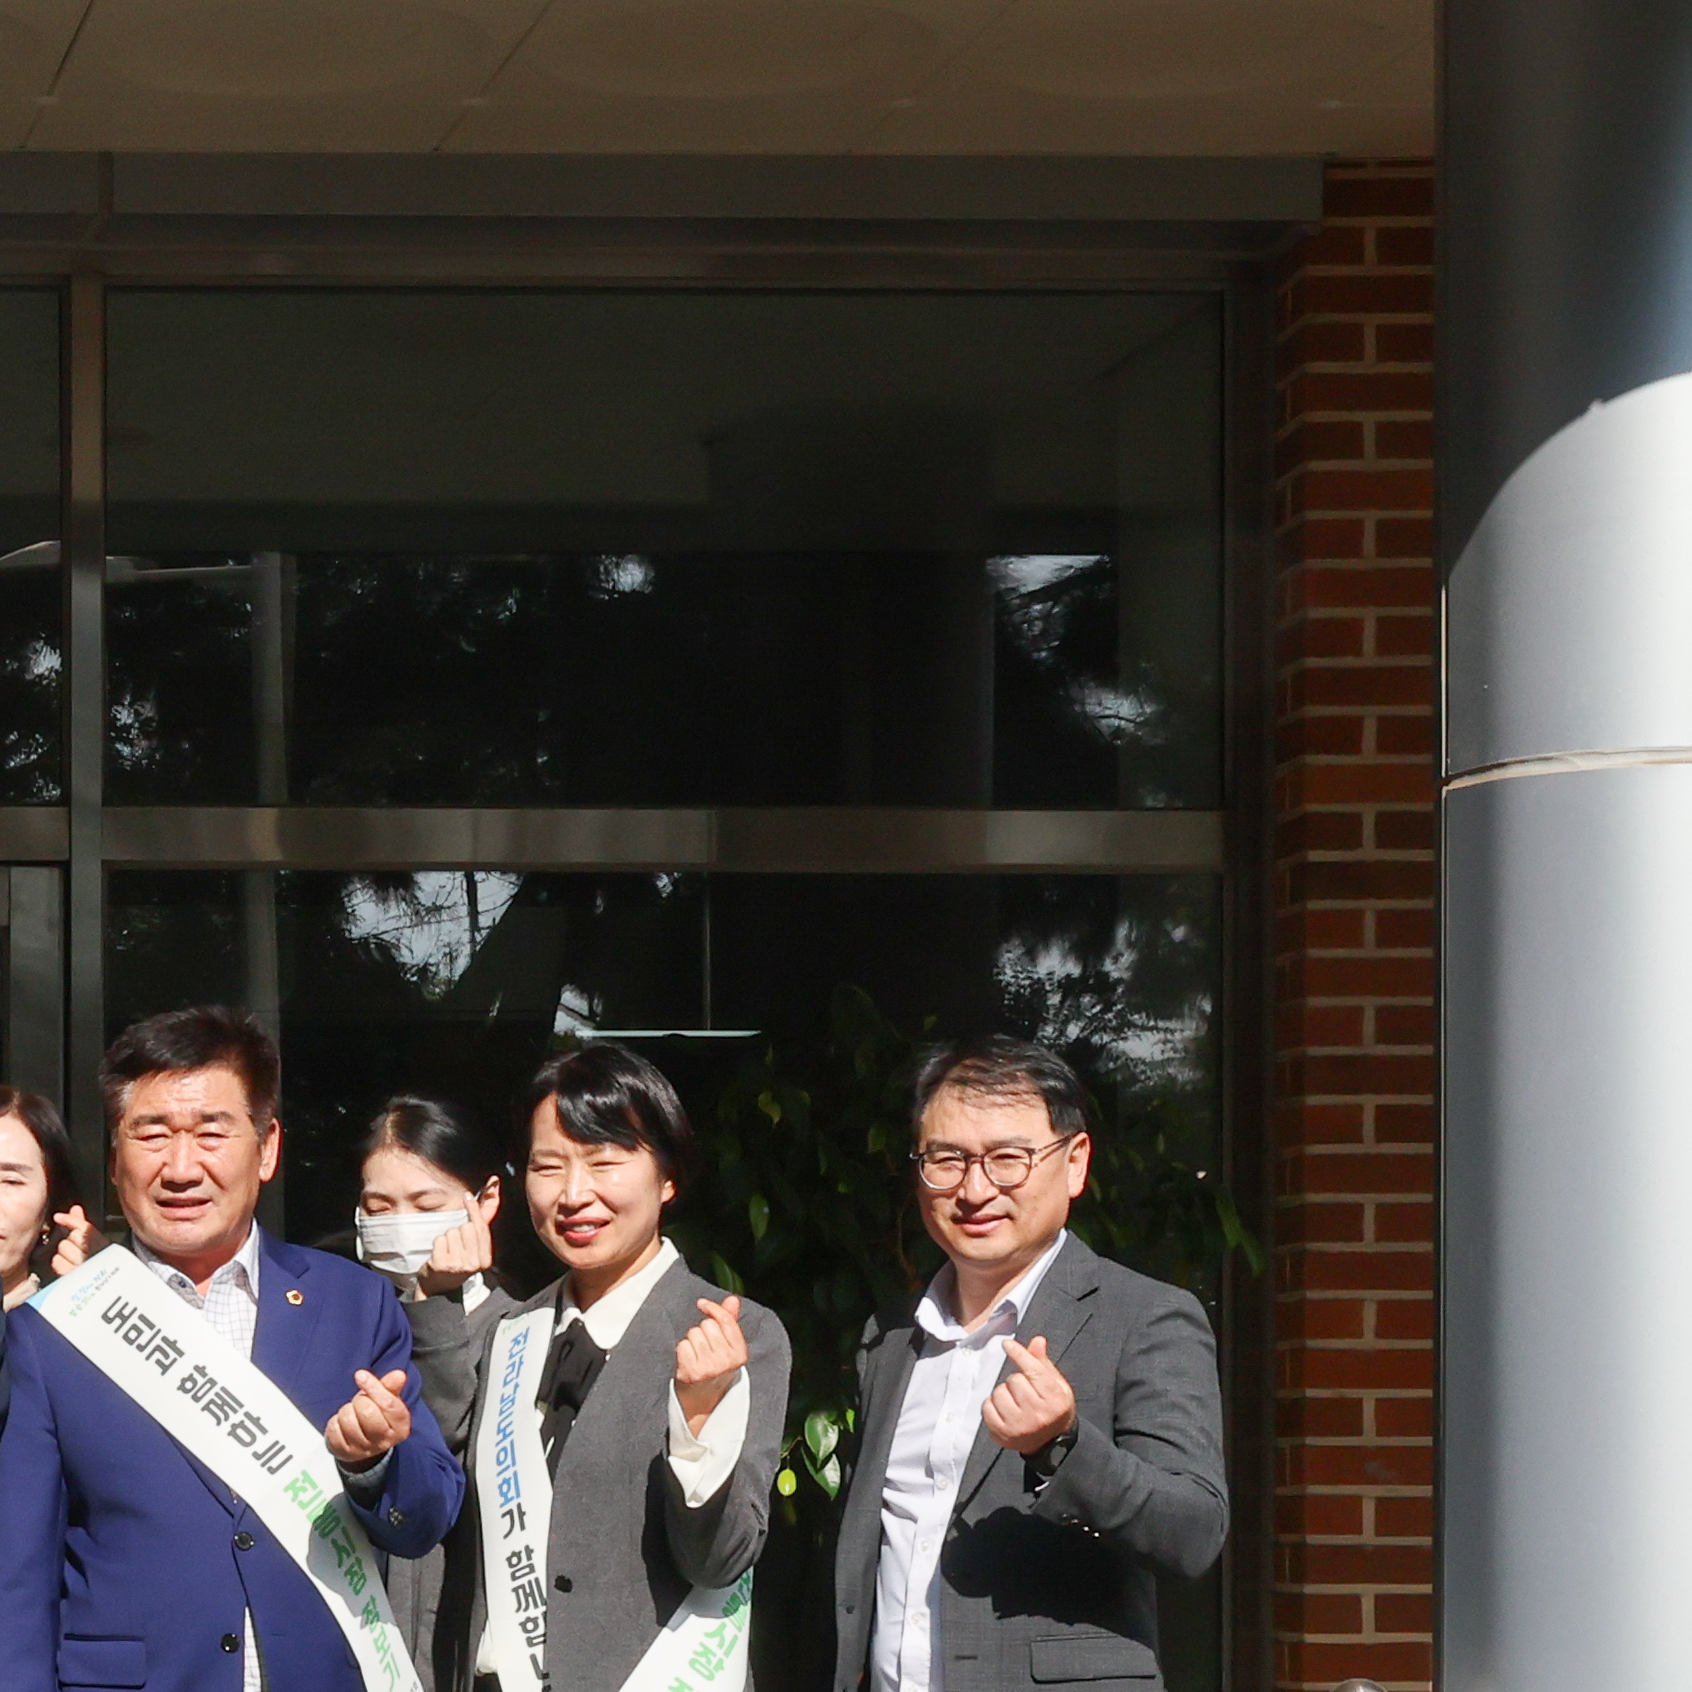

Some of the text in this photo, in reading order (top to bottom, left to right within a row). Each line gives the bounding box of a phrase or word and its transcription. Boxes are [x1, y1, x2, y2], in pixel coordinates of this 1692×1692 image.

[101, 1294, 401, 1692] 도민과 함께하는 전통시장 장보기
[495, 1326, 530, 1540] 전라남도의회가
